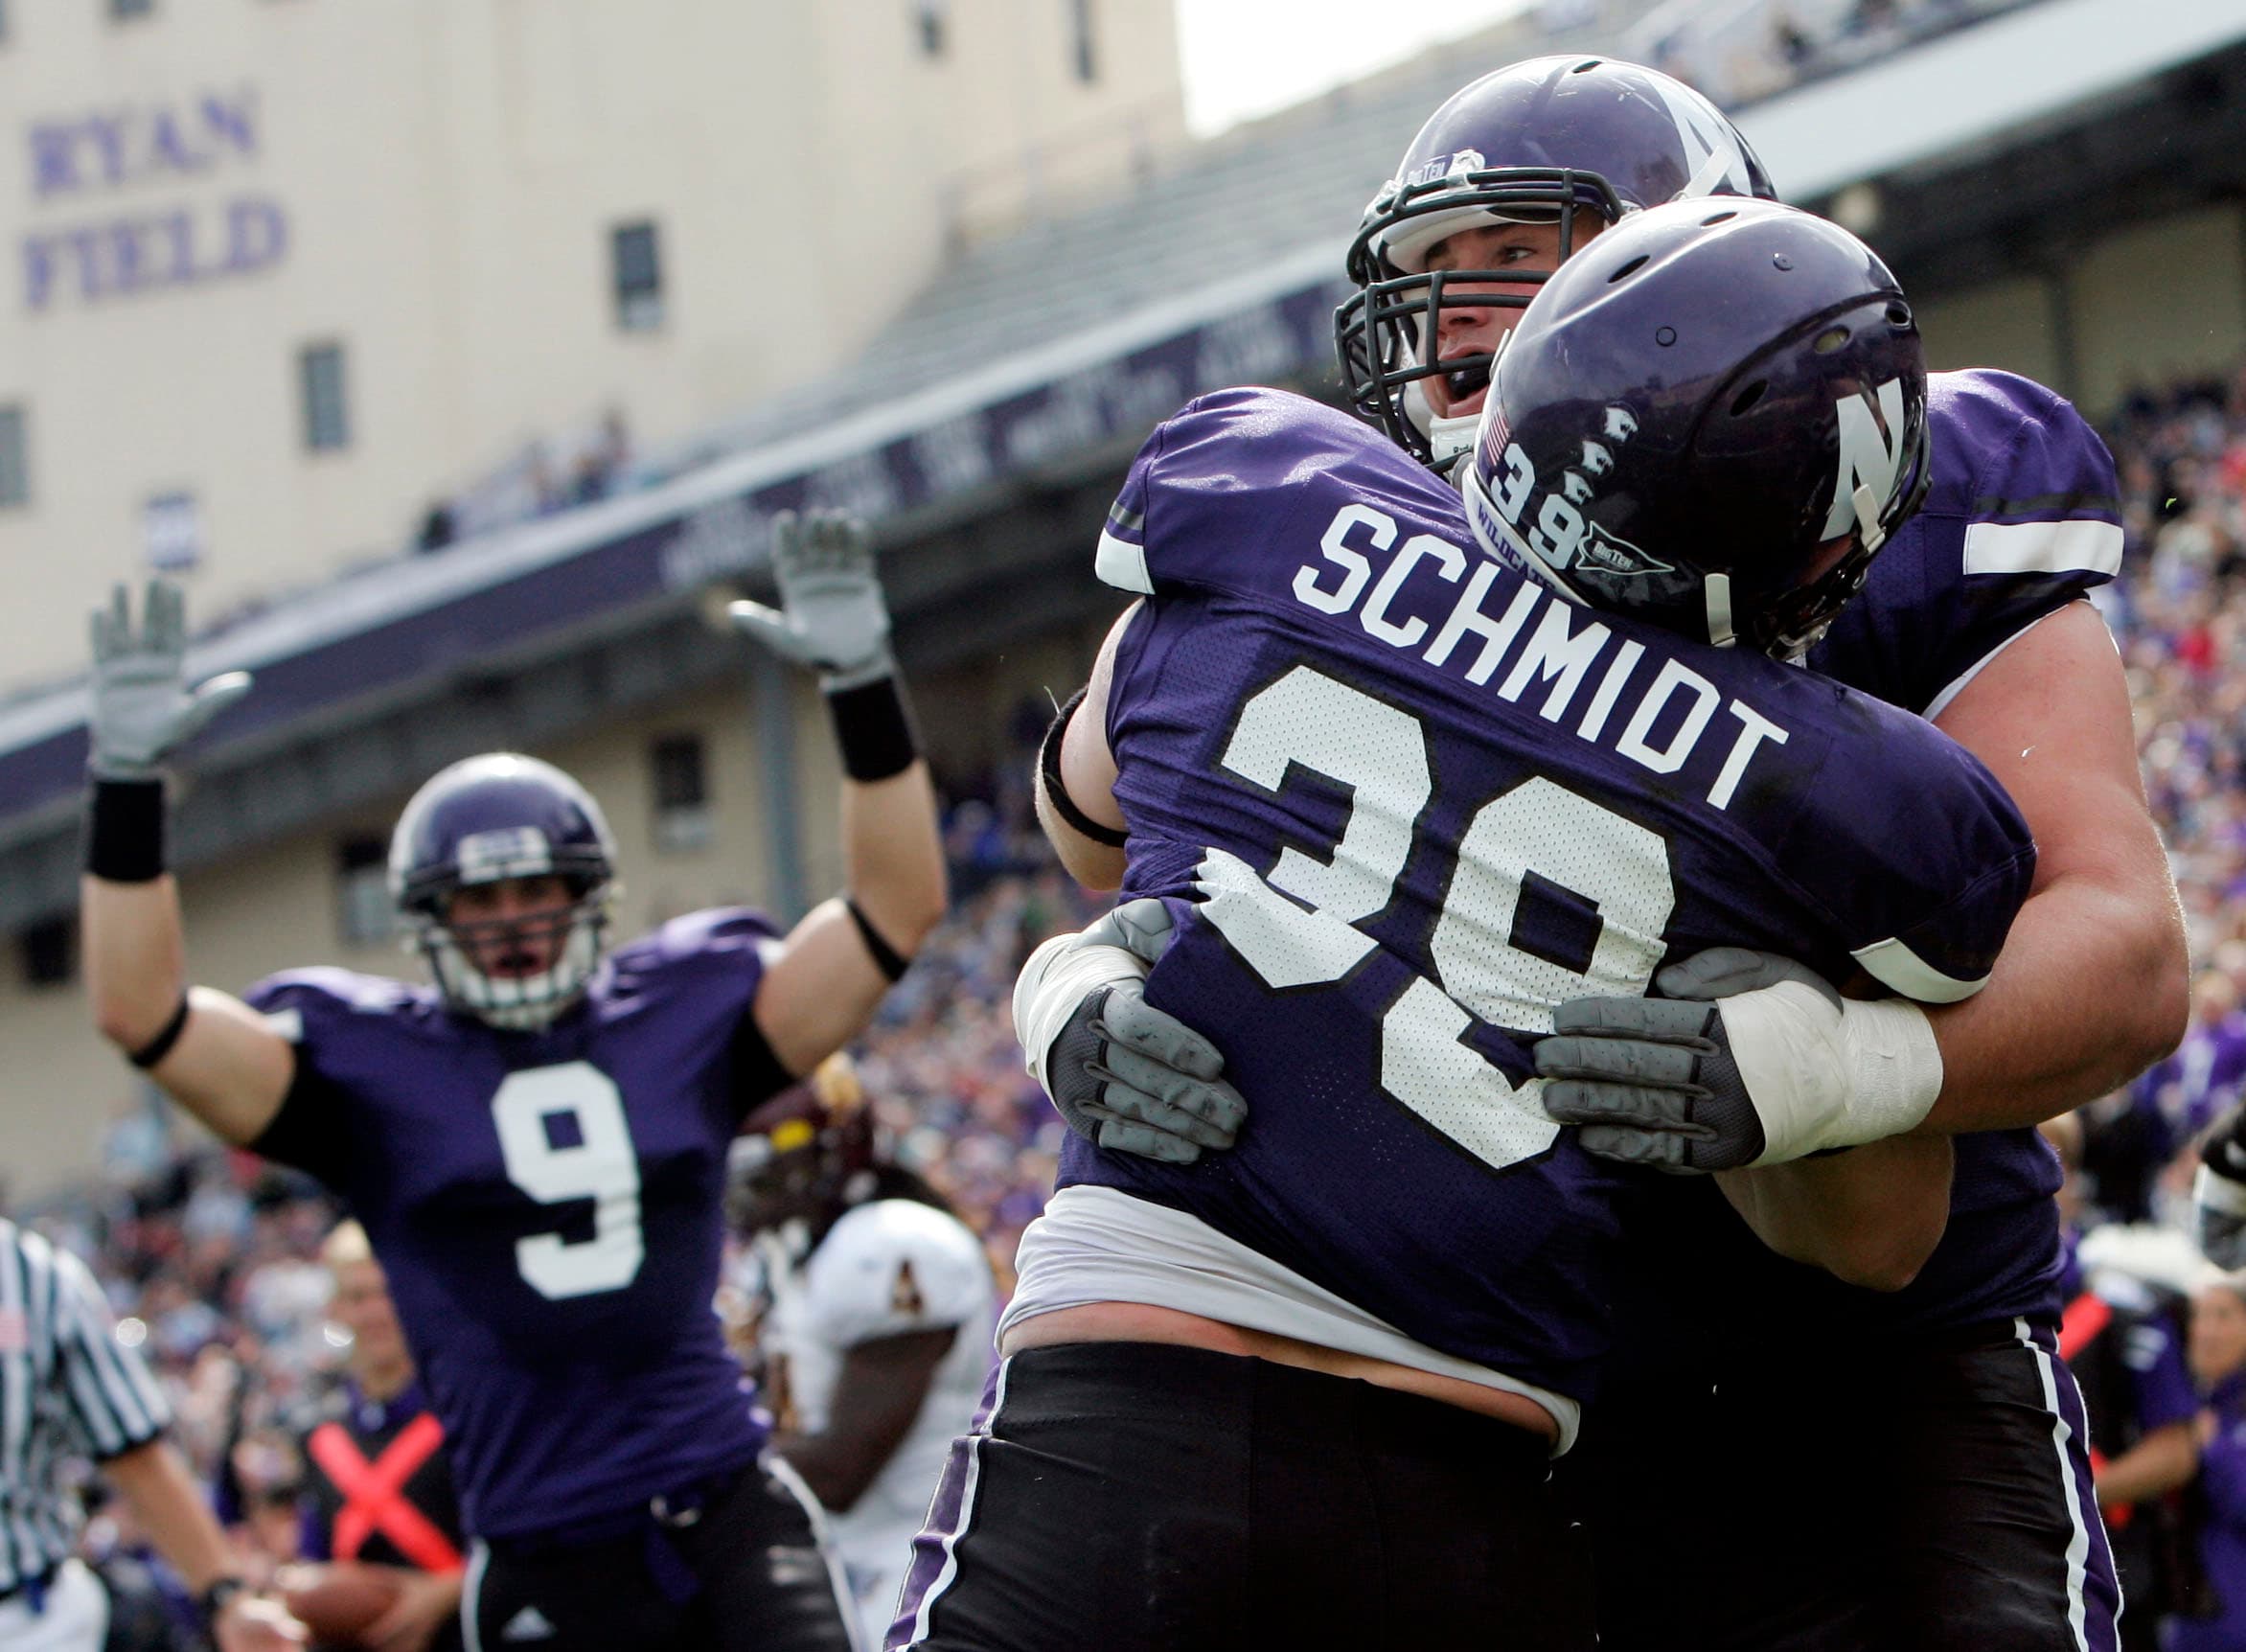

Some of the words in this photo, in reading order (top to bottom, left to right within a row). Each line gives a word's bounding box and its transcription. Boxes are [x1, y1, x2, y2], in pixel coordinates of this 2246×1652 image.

[28, 91, 259, 197] RYAN
[22, 198, 289, 310] FIELD
[1490, 443, 1586, 570] 39
[1819, 377, 1904, 542] N
[1293, 503, 1789, 811] SCHMIDT
[1193, 664, 1676, 1169] 39
[492, 1061, 643, 1299] 9
